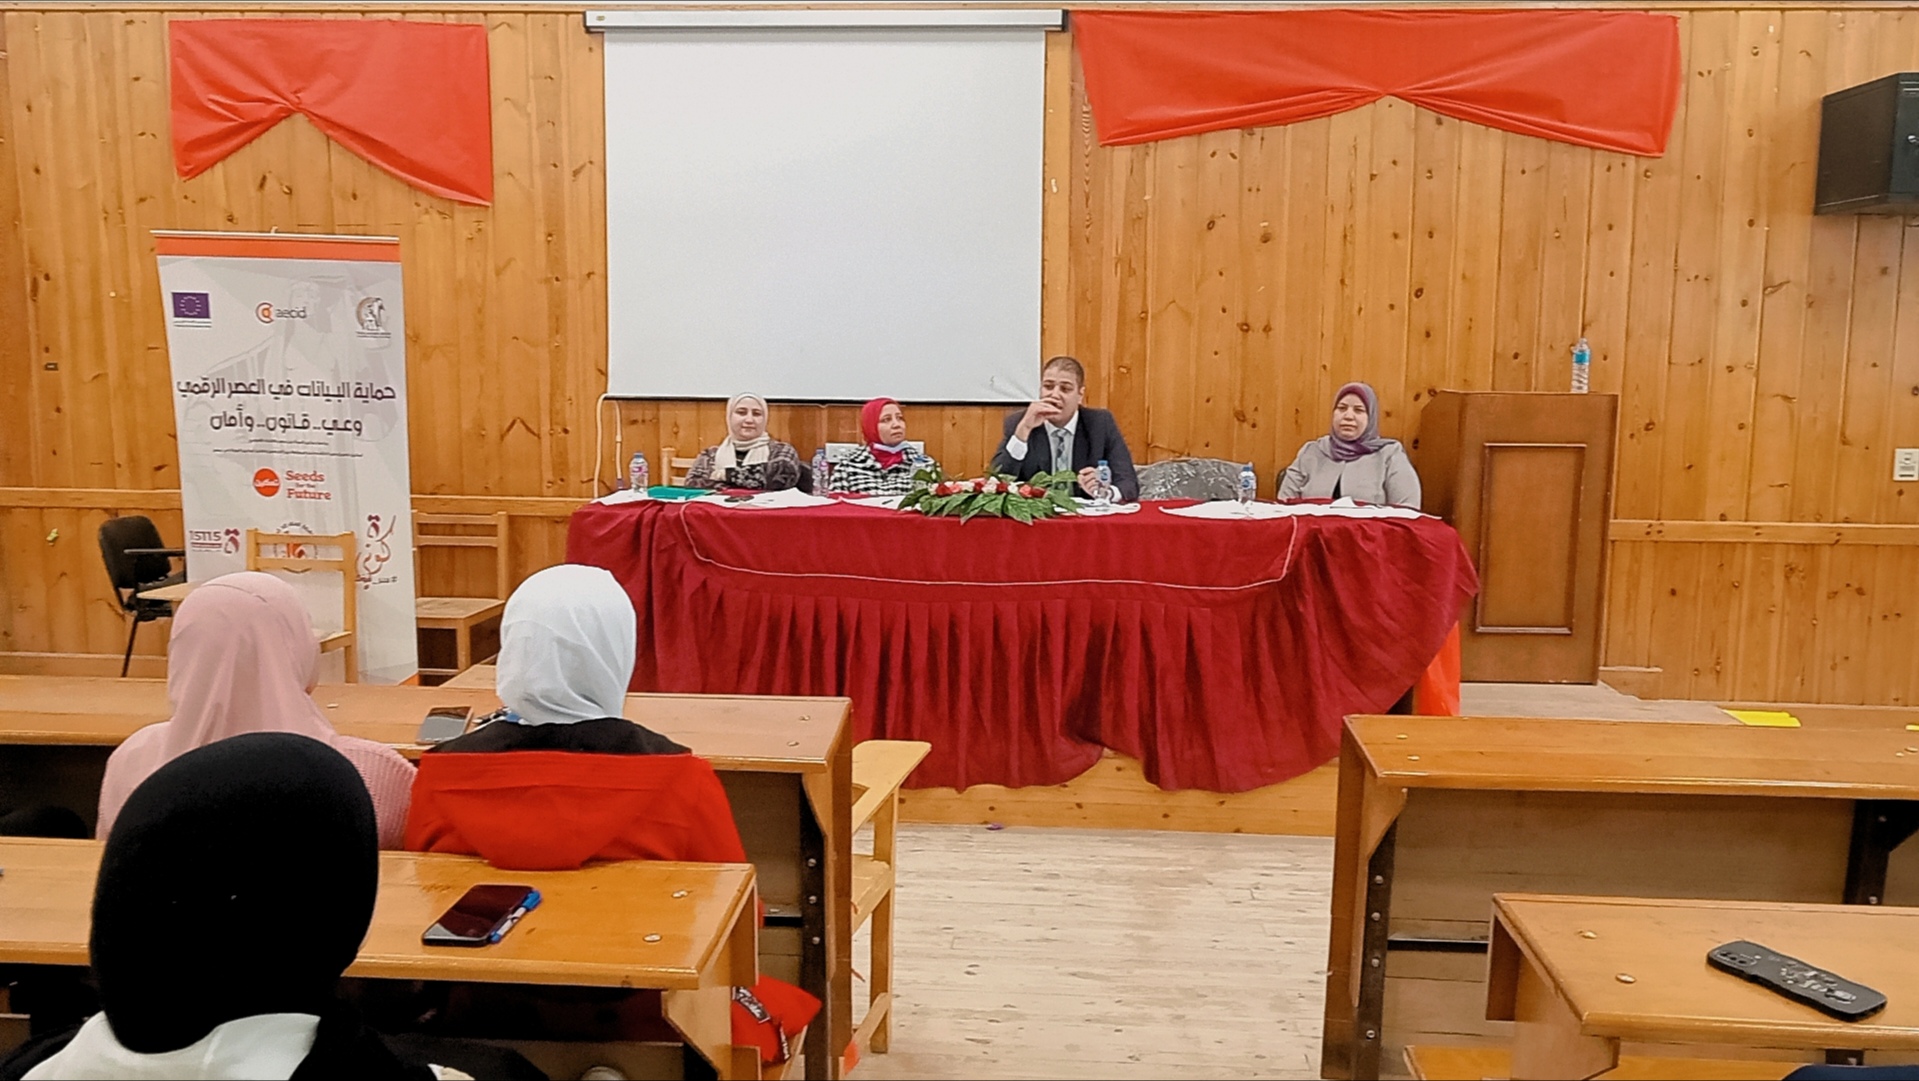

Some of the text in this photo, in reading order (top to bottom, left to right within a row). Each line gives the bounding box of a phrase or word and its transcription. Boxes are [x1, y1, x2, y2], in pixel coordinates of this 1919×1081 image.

[275, 306, 307, 319] aecid
[176, 376, 396, 403] حماية البيانات في العصر الرقمي
[209, 403, 255, 433] وأمان
[285, 470, 325, 482] Seeds
[286, 488, 332, 500] Future
